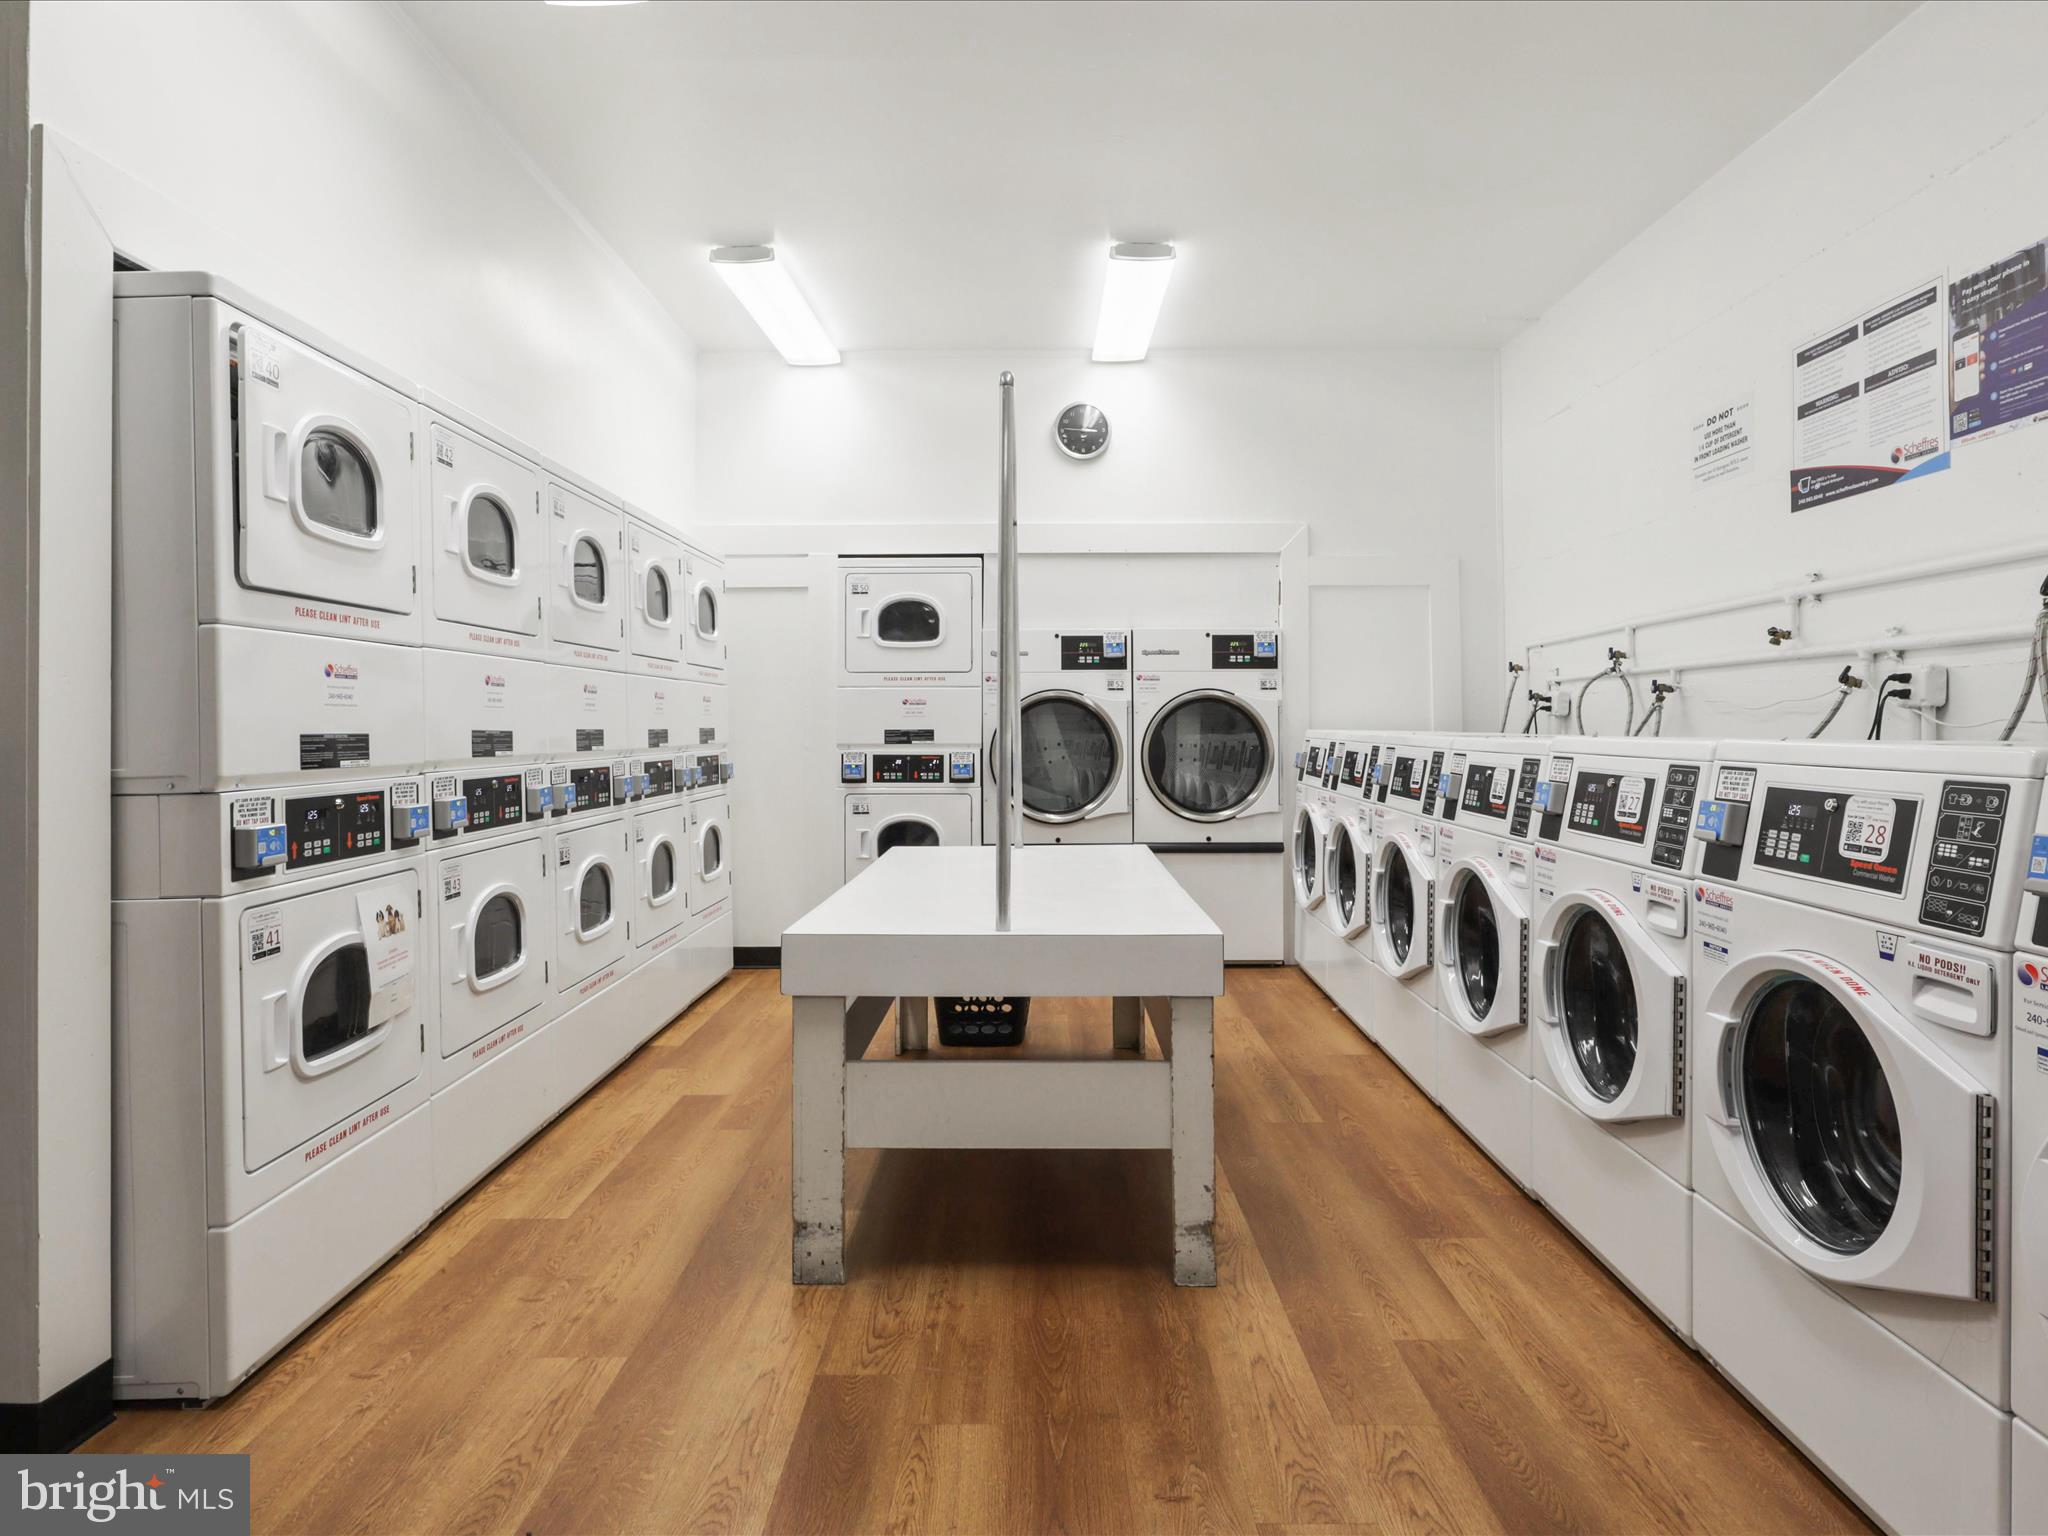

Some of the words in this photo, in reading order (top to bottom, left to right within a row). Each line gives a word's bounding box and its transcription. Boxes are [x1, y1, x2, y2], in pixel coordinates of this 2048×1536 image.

[1962, 288, 1972, 296] Pay
[1973, 280, 1986, 290] with
[1987, 273, 2002, 286] your
[2002, 264, 2022, 279] phone
[2023, 260, 2030, 268] in
[1966, 294, 1980, 304] easy
[1980, 284, 1999, 298] steps!
[264, 360, 280, 380] 40
[1706, 416, 1716, 426] DO
[1718, 408, 1734, 422] NOT
[1904, 437, 1938, 454] Scheffres
[294, 606, 318, 620] PLEASE
[319, 610, 338, 622] CLEAN
[339, 614, 352, 624] LINT
[352, 616, 368, 626] AFTER
[370, 619, 380, 629] USE
[1628, 796, 1640, 810] 27
[1864, 824, 1886, 845] 28
[1850, 859, 1873, 870] Speed
[1874, 864, 1898, 874] Queen
[452, 878, 461, 892] 43
[1706, 888, 1734, 907] Scheffres
[266, 929, 280, 946] 41
[1919, 953, 1930, 964] NO
[1934, 958, 1966, 974] PODS!!
[1918, 964, 1932, 972] LIQUID
[1934, 968, 1963, 982] DETERGENT
[1966, 976, 1980, 986] ONLY
[1840, 976, 1872, 996] DONE
[304, 1142, 327, 1162] PLEASE
[328, 1130, 347, 1147] CLEAN
[348, 1120, 361, 1136] LINT
[362, 1110, 378, 1127] AFTER
[380, 1104, 390, 1117] USE
